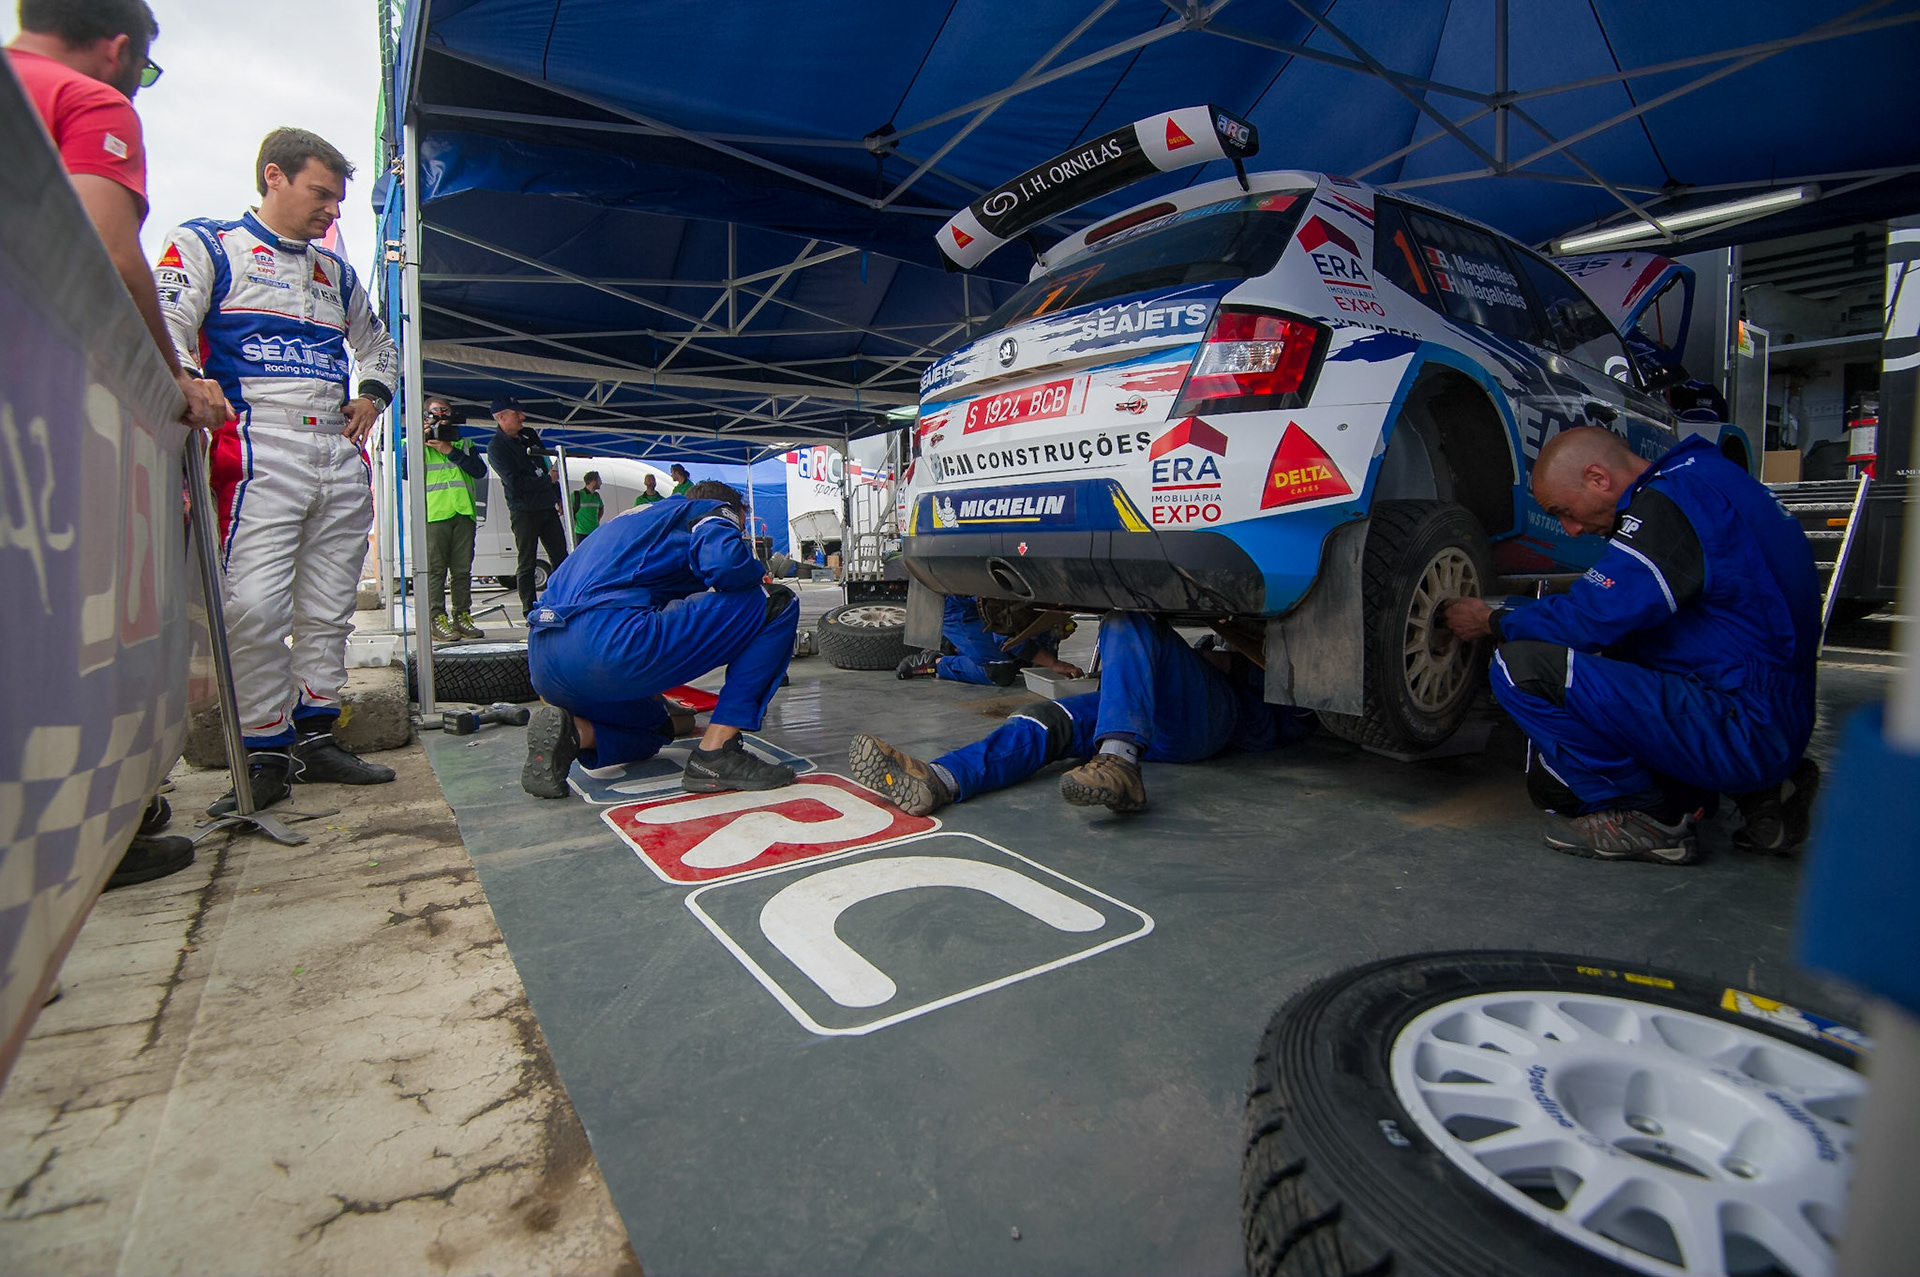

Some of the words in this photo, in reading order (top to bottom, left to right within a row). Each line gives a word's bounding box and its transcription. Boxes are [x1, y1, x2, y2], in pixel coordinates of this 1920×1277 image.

[1168, 135, 1187, 145] DELTA
[1020, 184, 1031, 201] J.
[1031, 176, 1051, 194] H.
[1049, 138, 1123, 185] ORNELAS
[255, 253, 274, 264] ERA
[1311, 253, 1369, 281] ERA
[1393, 229, 1428, 295] 1
[1451, 253, 1519, 287] Magalhães
[1033, 284, 1067, 317] 1
[1447, 273, 1463, 296] H.
[1461, 277, 1528, 310] Magalhães
[1333, 296, 1386, 317] EXPO
[1081, 304, 1207, 341] SEAJETS
[242, 343, 348, 374] SEAJETS
[264, 363, 300, 375] Racing
[967, 404, 978, 430] S
[986, 396, 1020, 425] 1924
[1029, 386, 1066, 416] BCB
[977, 431, 1152, 469] CONSTRUÇÕES
[1152, 455, 1222, 483] ERA
[1274, 465, 1332, 488] DELTA
[959, 495, 1066, 518] MICHELIN
[1151, 491, 1222, 503] IMOBILIÁRIA
[1152, 504, 1222, 524] EXPO
[690, 760, 720, 778] salomon
[1528, 1063, 1575, 1129] speedline
